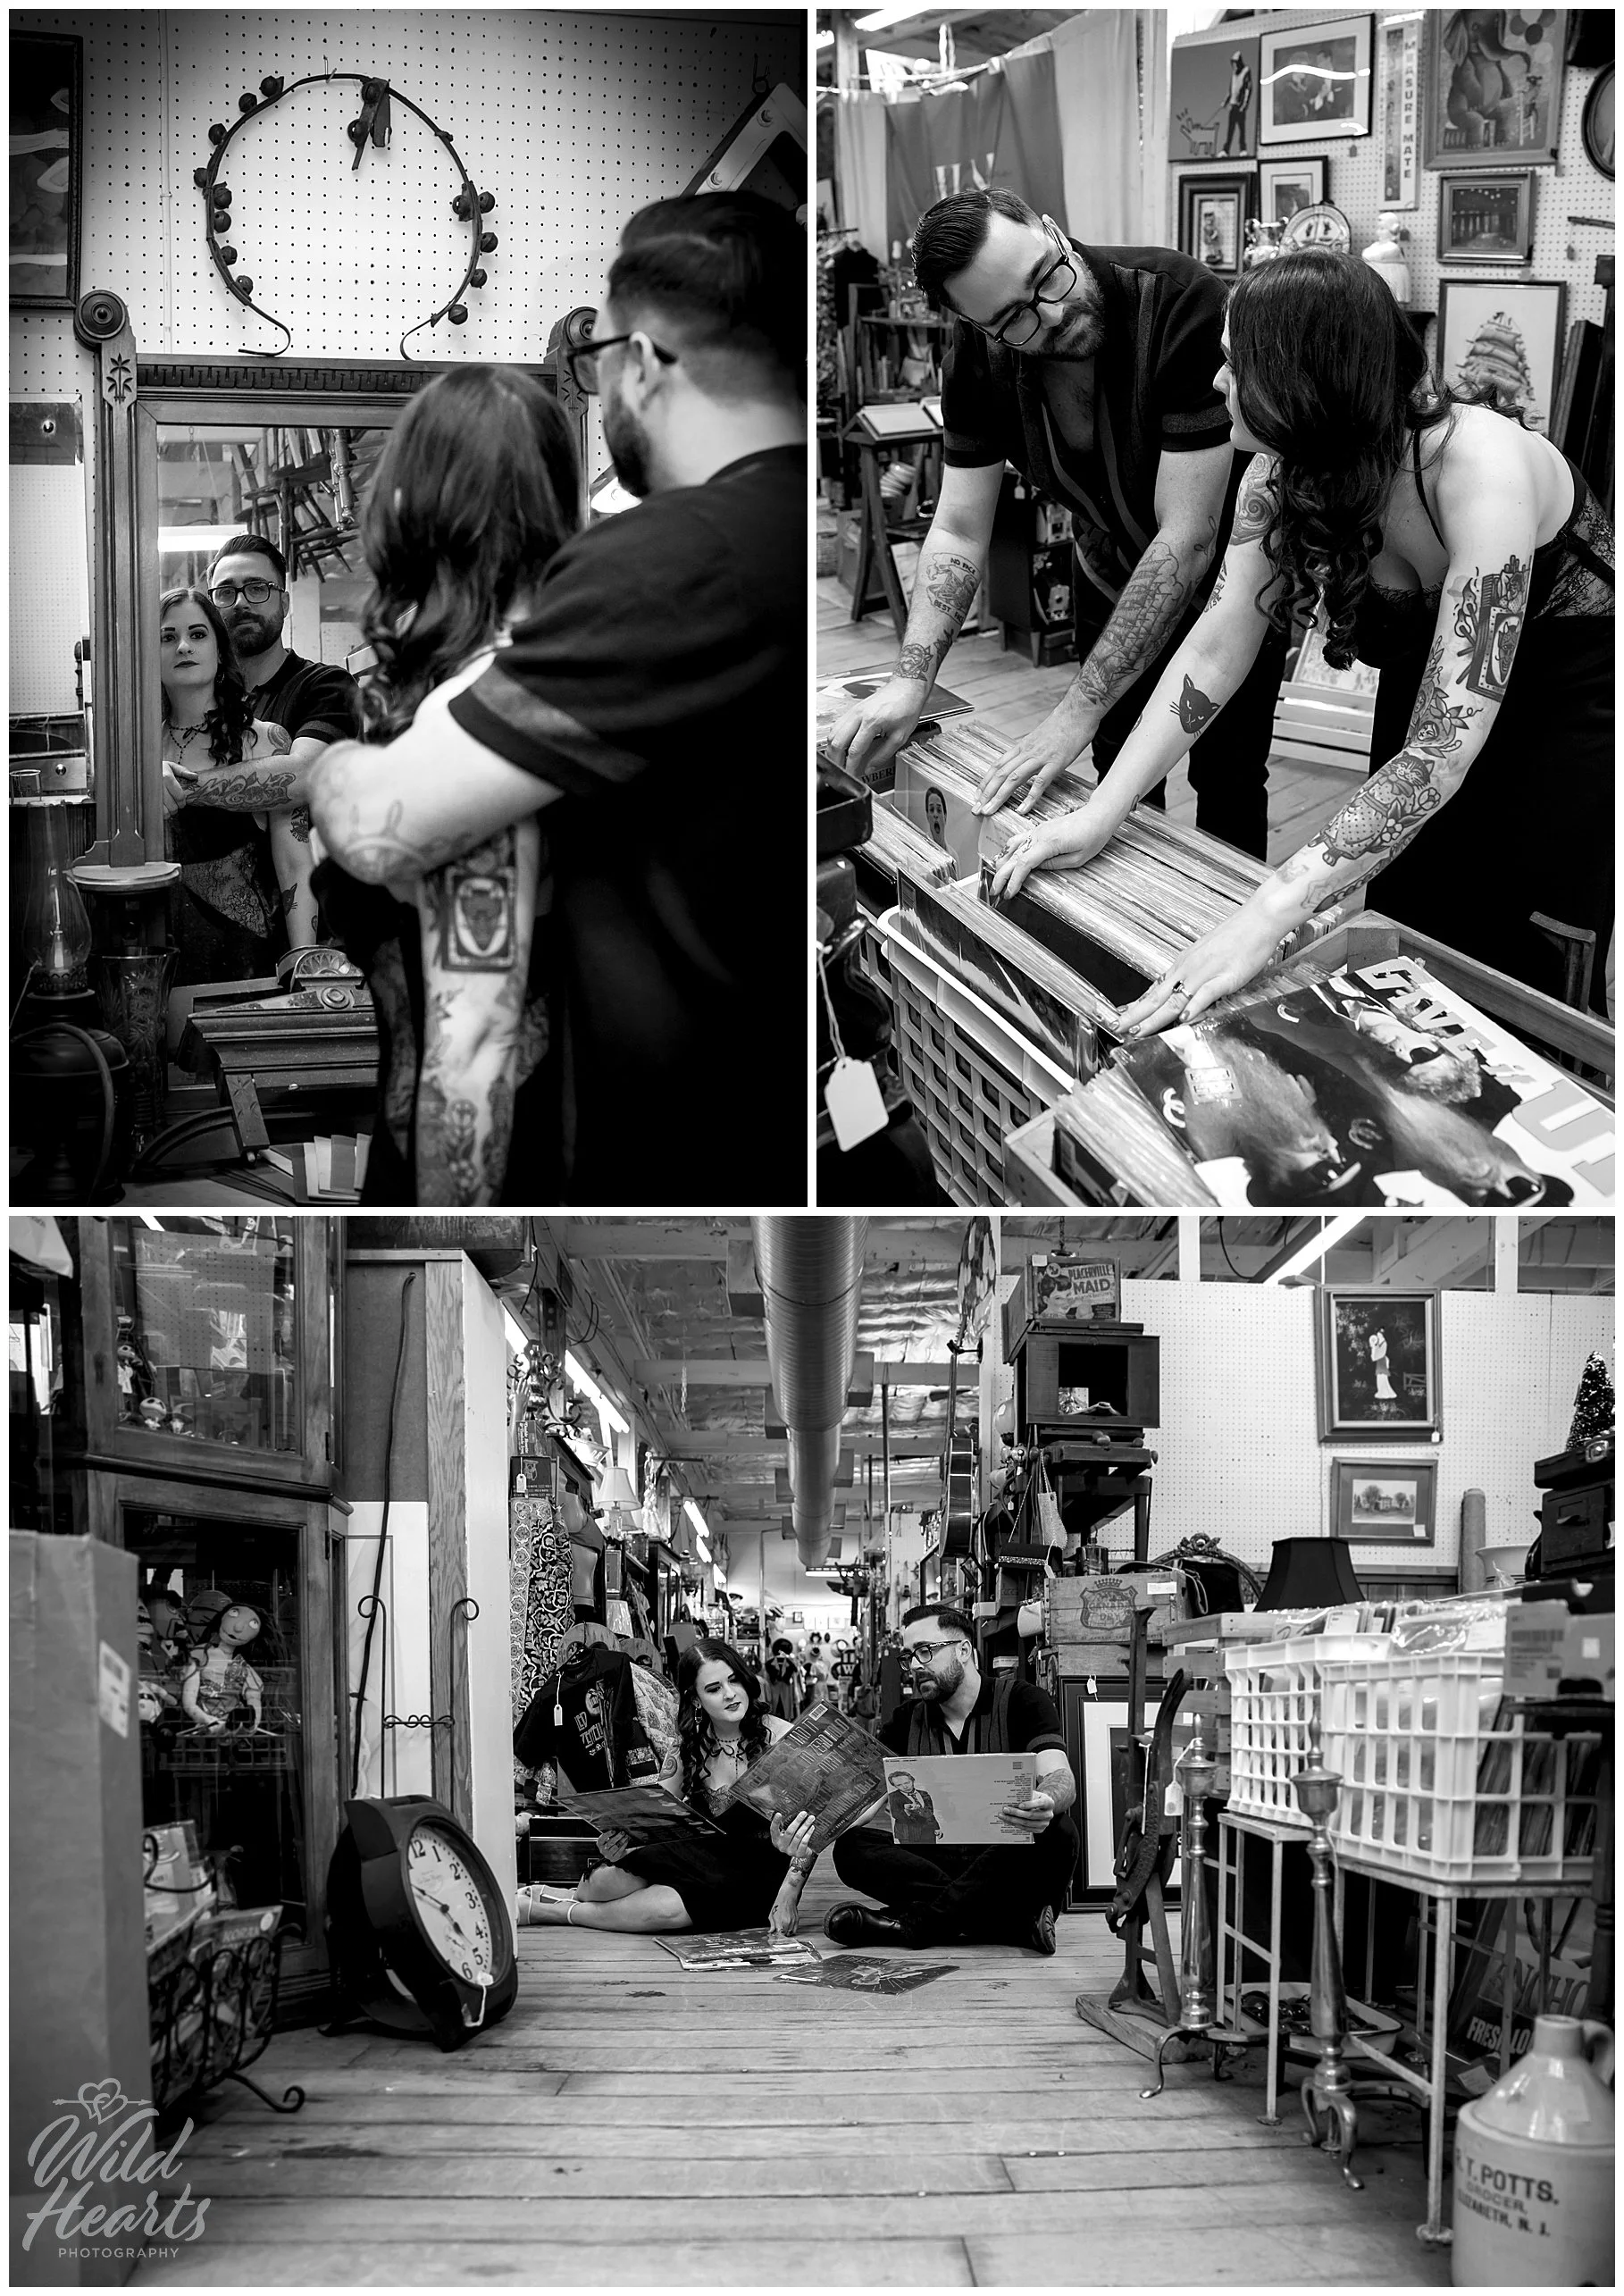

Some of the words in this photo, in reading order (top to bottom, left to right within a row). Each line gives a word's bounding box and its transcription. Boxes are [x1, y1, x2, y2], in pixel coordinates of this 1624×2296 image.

[1403, 40, 1416, 124] MEASURE
[1402, 135, 1414, 179] MATE
[950, 557, 961, 566] NO
[933, 599, 951, 612] BEST
[1354, 955, 1497, 1063] GIVE
[1072, 1278, 1111, 1295] MAID
[807, 1733, 834, 1756] ZERO
[824, 1717, 850, 1742] HOLD
[409, 1839, 426, 1858] 12
[432, 1845, 441, 1863] 1
[449, 1864, 461, 1881] 2
[465, 1891, 476, 1909] 3
[475, 1921, 484, 1939] 4
[472, 1947, 483, 1965] 5
[461, 1962, 473, 1980] 6
[1466, 2015, 1503, 2052] FRES
[1480, 2163, 1560, 2205] POTTS.
